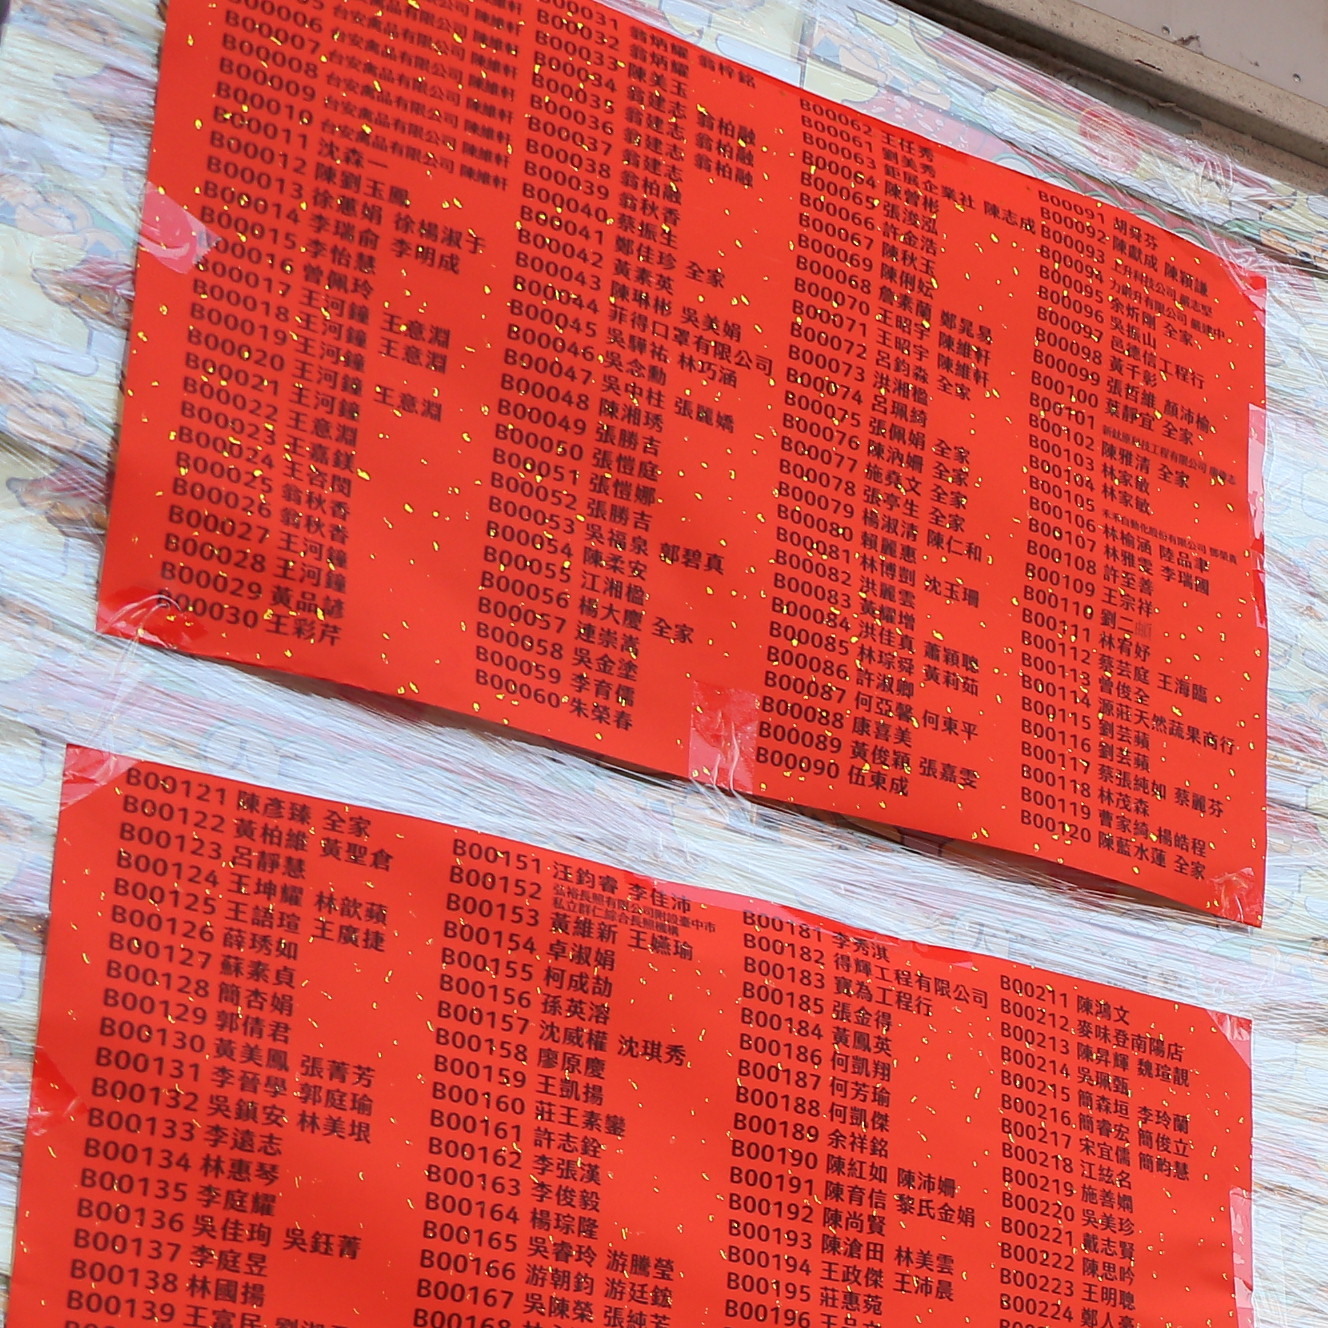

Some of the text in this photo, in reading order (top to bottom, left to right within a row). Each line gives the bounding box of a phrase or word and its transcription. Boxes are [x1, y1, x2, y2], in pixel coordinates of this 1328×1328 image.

[537, 31, 619, 70] B00033
[212, 105, 388, 169] B00011 沈森一
[801, 115, 872, 153] B00061
[803, 131, 876, 169] B00063
[984, 201, 1036, 235] 陳志成
[198, 205, 297, 250] B00015
[199, 180, 302, 225] B00014
[392, 238, 460, 275] 李明成
[520, 205, 604, 245] B00041
[686, 261, 726, 289] 全家
[512, 274, 599, 314] B00044
[497, 398, 661, 457] B00049 張勝吉
[775, 481, 855, 519] B00079
[927, 529, 982, 562] 陳仁和
[1025, 562, 1153, 618] B00109 王宗祥
[476, 621, 639, 682] B00058 吳金塗
[1021, 630, 1091, 665] B00112
[475, 668, 633, 731] B00060 朱榮春
[1020, 672, 1091, 708] B00114
[761, 695, 912, 748] B00088 康喜美
[756, 747, 909, 797] B00090 伍東成
[1021, 763, 1149, 817] B00118 林茂森
[125, 766, 226, 806] B00121
[323, 810, 372, 838] 全家
[119, 822, 306, 879] B00123 呂靜慧
[1021, 809, 1092, 844] B00120
[1174, 855, 1206, 880] 全家
[452, 838, 541, 874] B00151
[629, 872, 691, 913] 李佳沛
[743, 933, 988, 1009] B00182 得輝工程有限公司
[744, 956, 825, 989] B00183
[437, 1000, 530, 1035] B00157
[742, 981, 893, 1034] B00185 張金得
[1000, 998, 1183, 1062] B00212 麥味登南陽店
[84, 1137, 279, 1186] B00134 林惠琴
[730, 1166, 813, 1196] B00191
[825, 1180, 886, 1210] 陳育信
[66, 1289, 176, 1323] B00139
